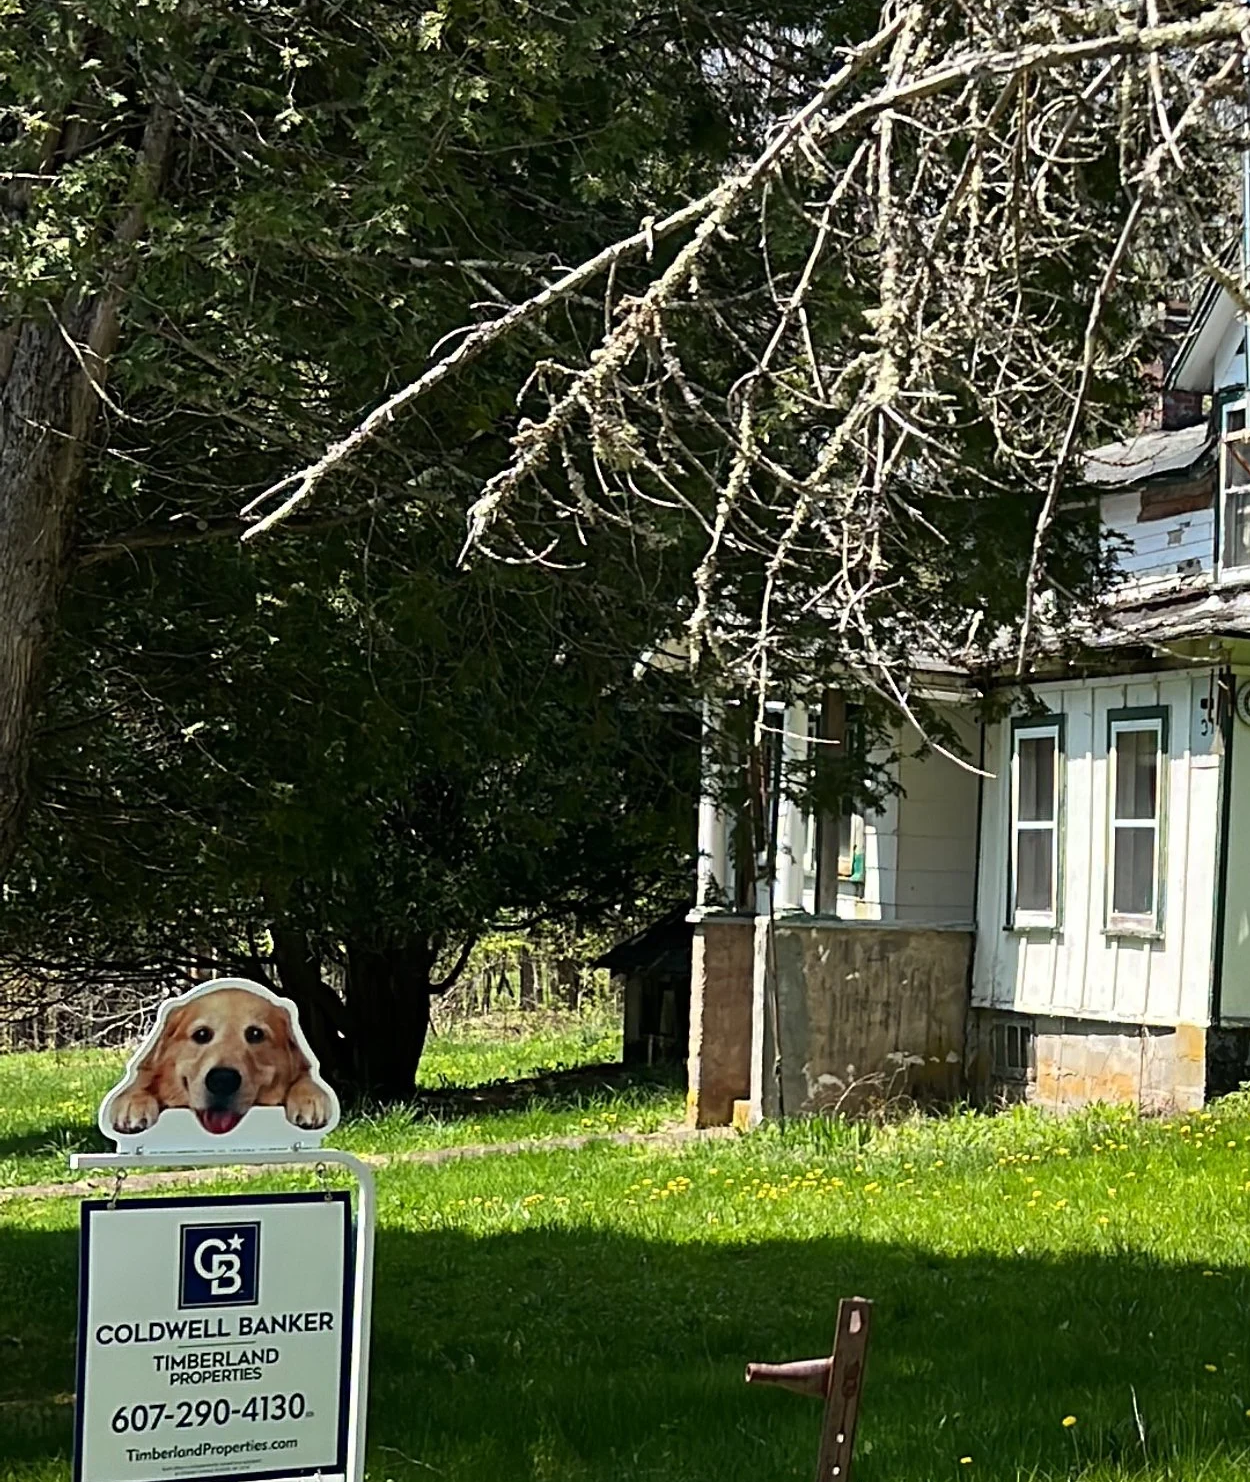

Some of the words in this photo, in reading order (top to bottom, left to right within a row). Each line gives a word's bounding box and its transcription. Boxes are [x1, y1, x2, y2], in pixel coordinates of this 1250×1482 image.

[95, 1318, 231, 1345] COLDWELL
[238, 1311, 334, 1336] BANKER
[153, 1348, 279, 1371] TIMBERLAND
[170, 1367, 262, 1385] PROPERTIES
[111, 1393, 305, 1433] 607-290-4130
[126, 1438, 298, 1462] TimberlandProperties.com
